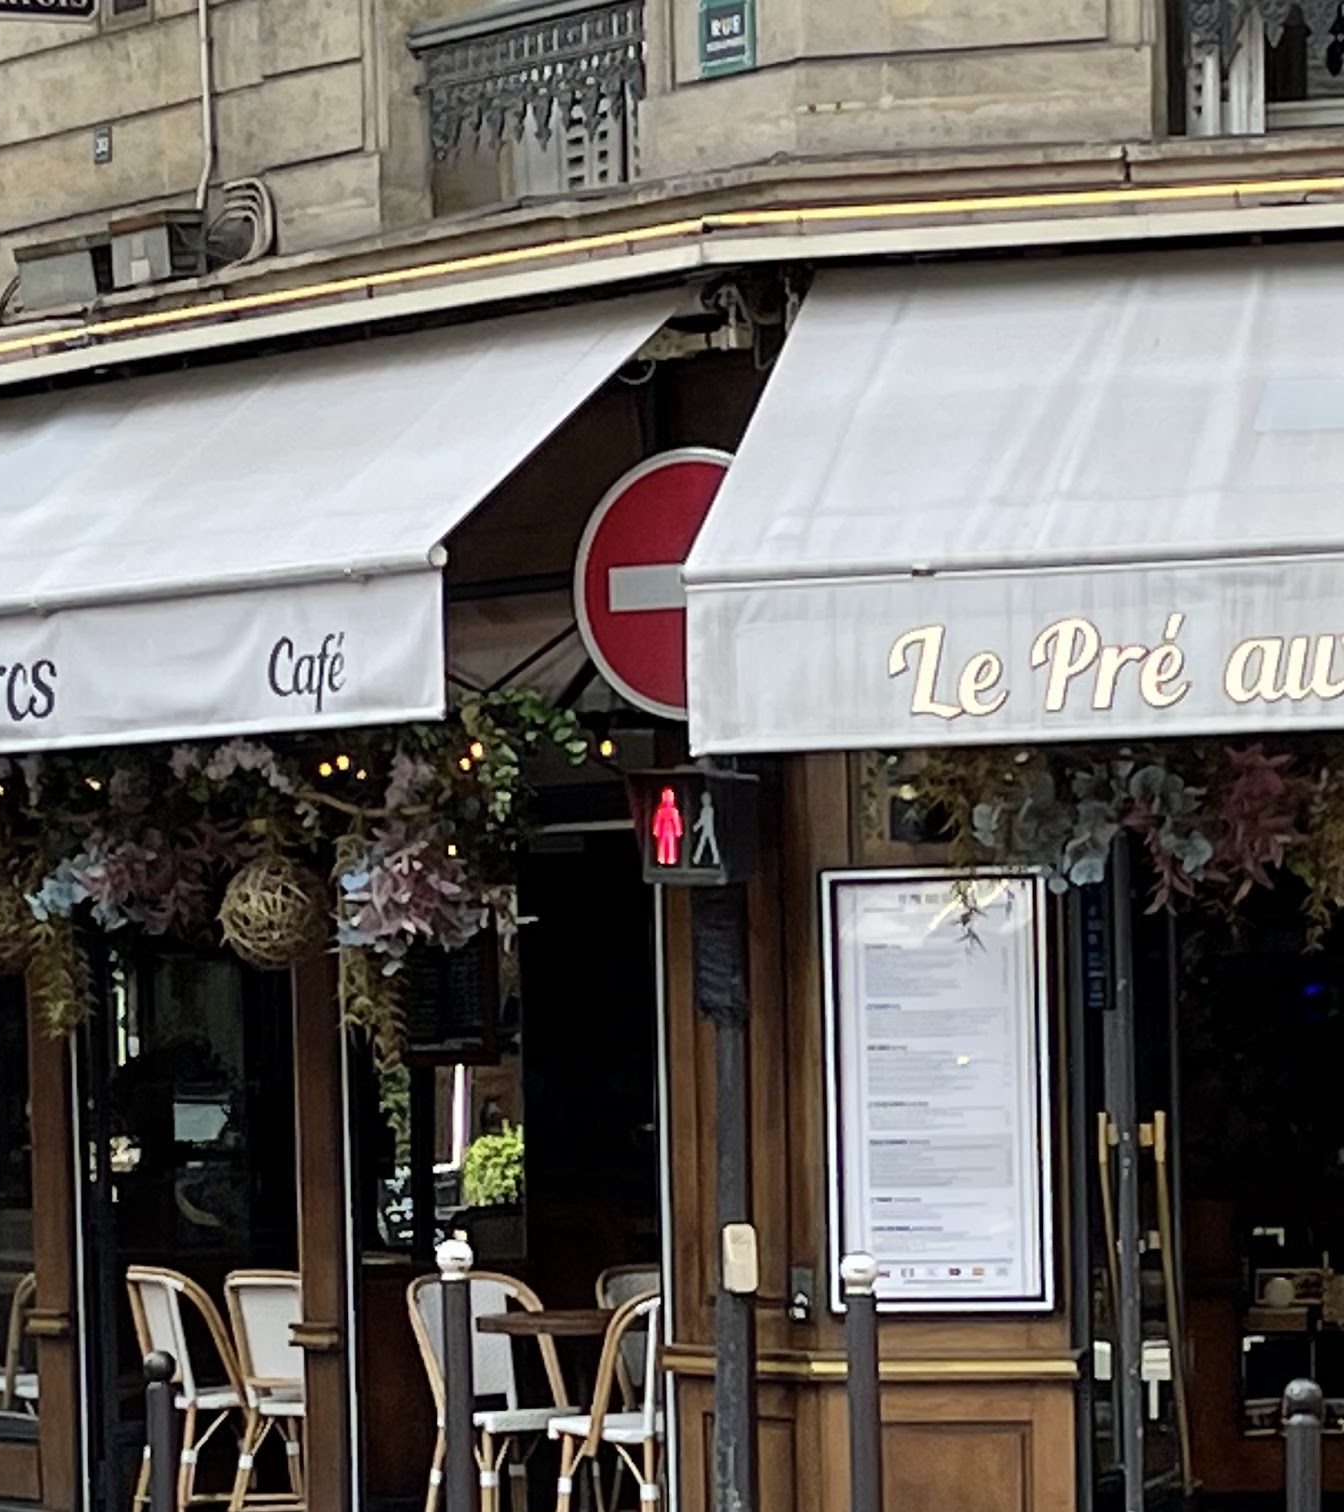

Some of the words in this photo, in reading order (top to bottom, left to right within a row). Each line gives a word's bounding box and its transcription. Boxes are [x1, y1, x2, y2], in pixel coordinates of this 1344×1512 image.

[267, 631, 346, 714] Café
[888, 623, 1010, 720] Le
[1031, 612, 1192, 712] Pré
